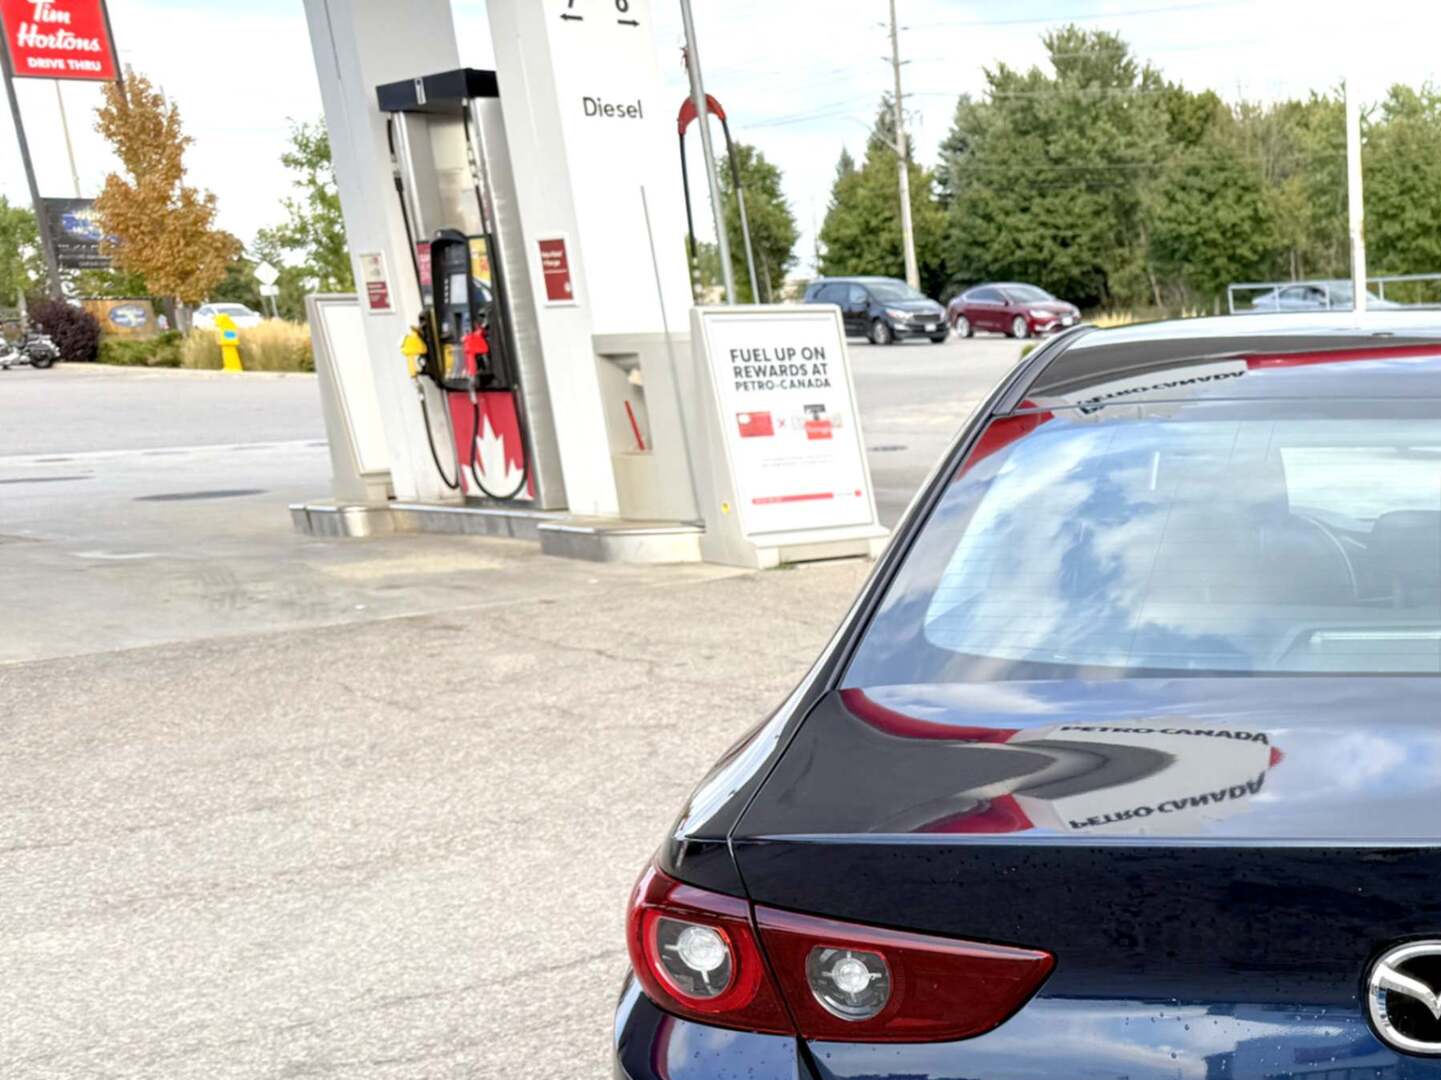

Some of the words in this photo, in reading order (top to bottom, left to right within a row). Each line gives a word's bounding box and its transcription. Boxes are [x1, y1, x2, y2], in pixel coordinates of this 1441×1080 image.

[27, 0, 71, 24] Tim
[17, 21, 102, 52] Hortons
[27, 57, 65, 70] DRIVE
[67, 59, 102, 72] THRU
[582, 96, 643, 119] Diesel
[730, 348, 771, 363] FUEL
[774, 347, 796, 362] UP
[801, 347, 826, 361] ON
[733, 364, 808, 379] REWARDS
[812, 363, 828, 376] AT
[734, 378, 831, 391] PETRO-CANADA
[1060, 726, 1269, 745] PETRO-CANADA
